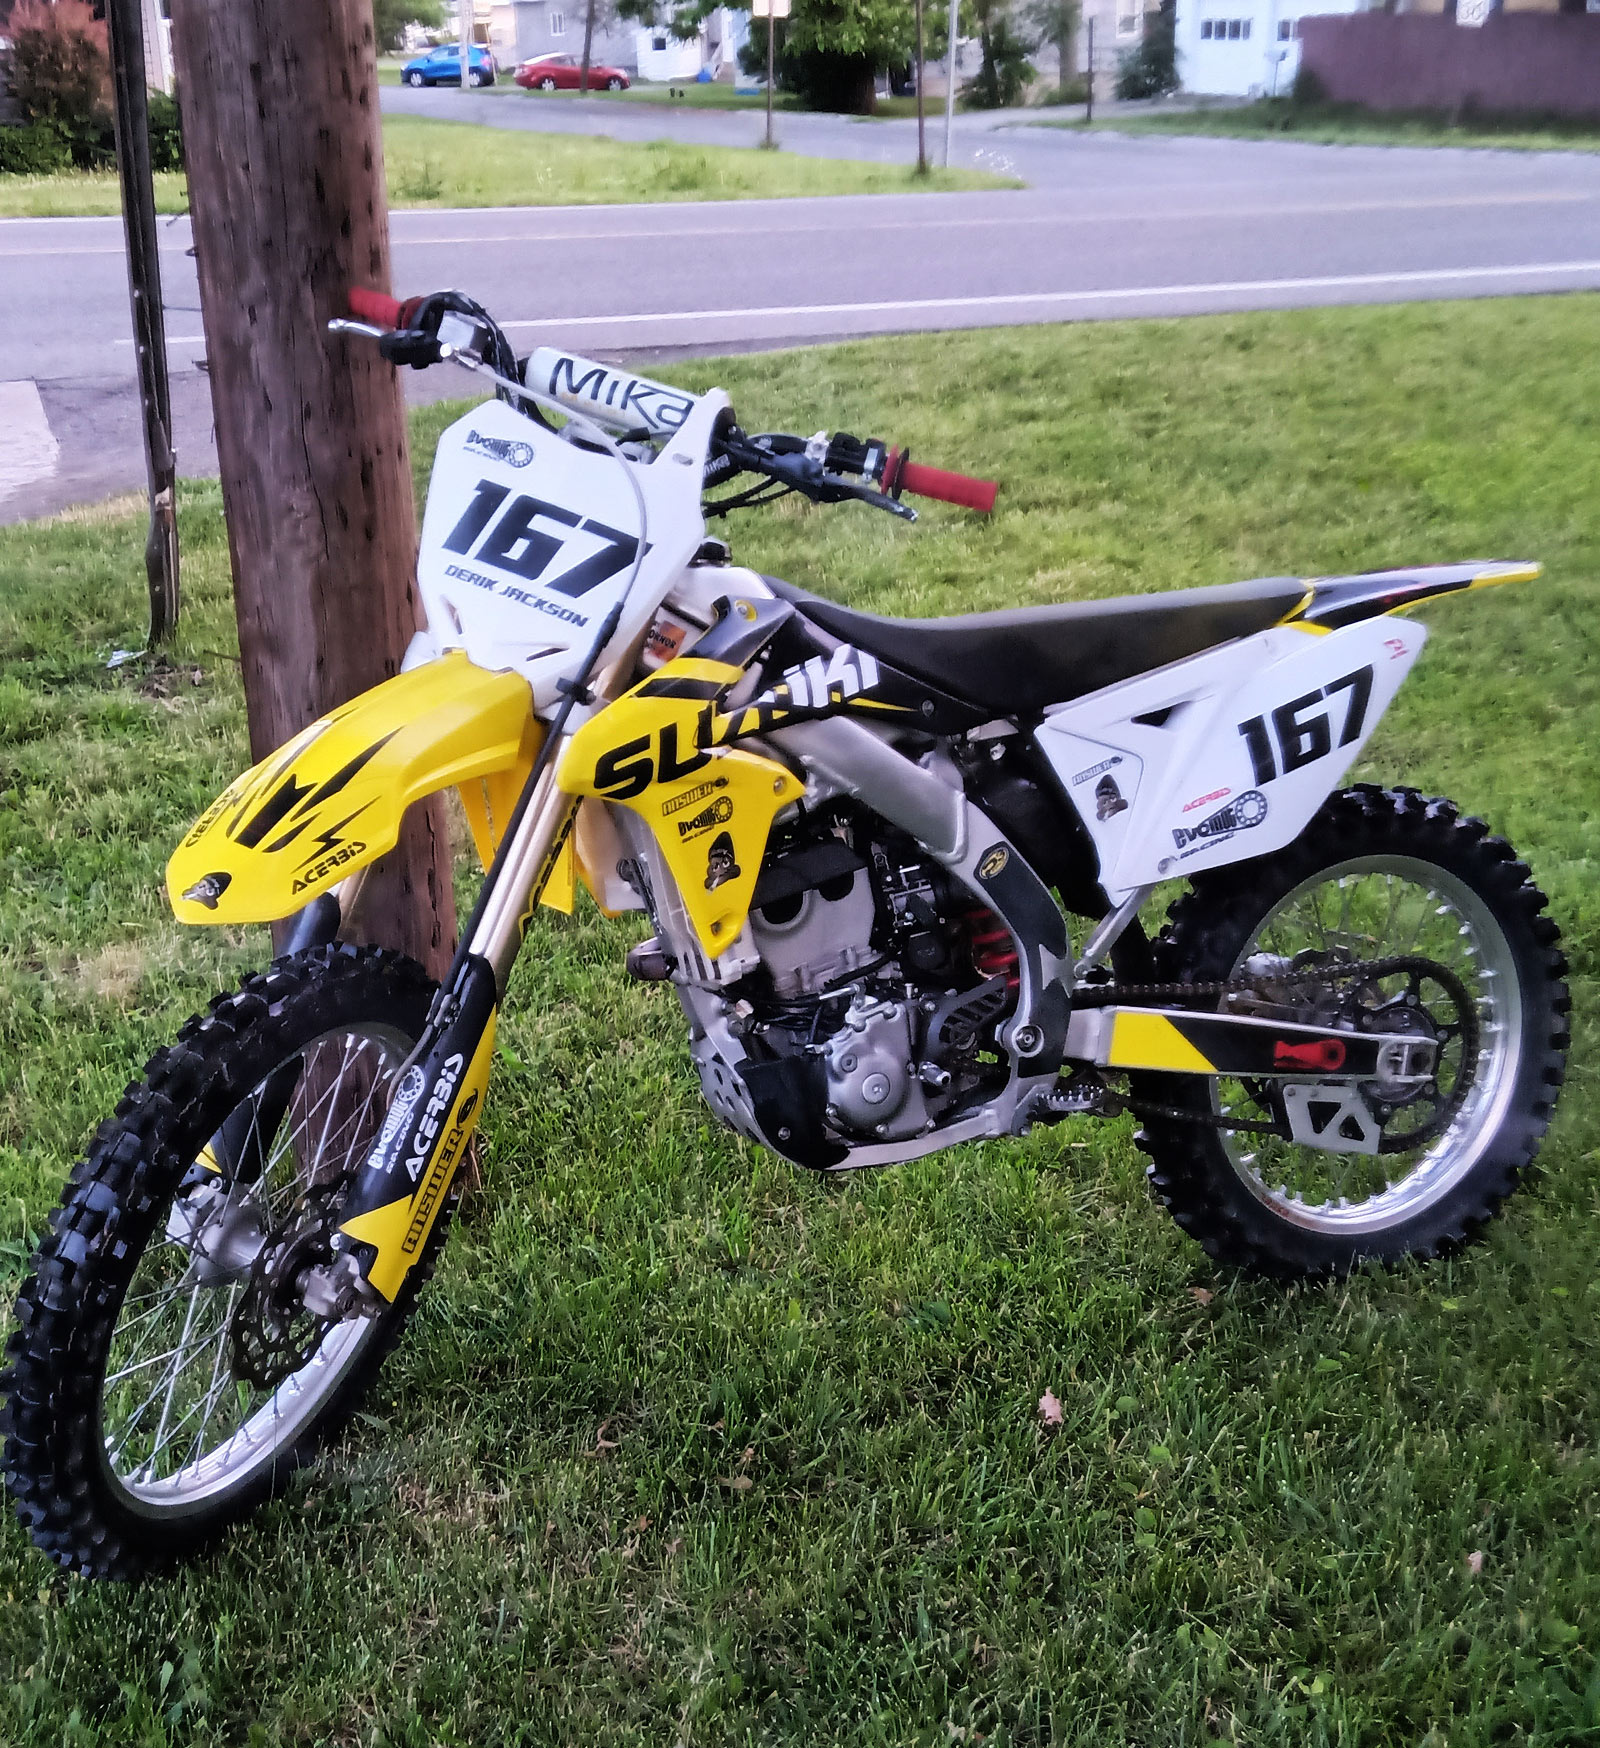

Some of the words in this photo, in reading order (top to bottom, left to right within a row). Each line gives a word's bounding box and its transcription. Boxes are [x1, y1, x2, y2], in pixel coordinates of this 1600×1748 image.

[441, 478, 654, 599] 167
[445, 564, 499, 591] DERIK
[498, 584, 592, 628] JACKSON
[1238, 664, 1374, 787] 167
